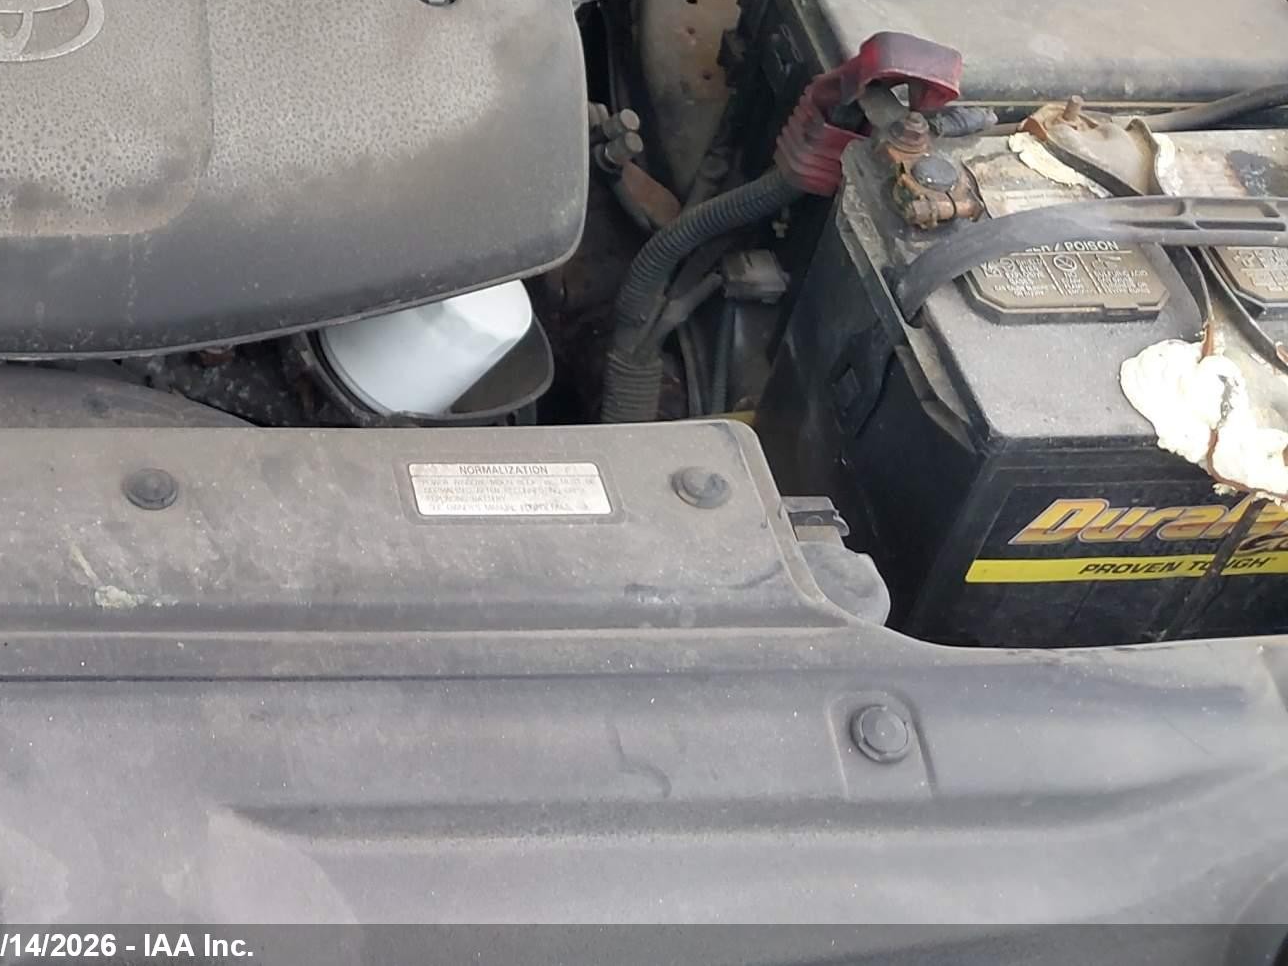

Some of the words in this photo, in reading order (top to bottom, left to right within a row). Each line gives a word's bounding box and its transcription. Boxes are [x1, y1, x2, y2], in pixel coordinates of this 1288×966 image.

[1064, 240, 1120, 251] POISON
[459, 465, 549, 475] NORMALIZATION
[1078, 561, 1180, 575] PROVEN
